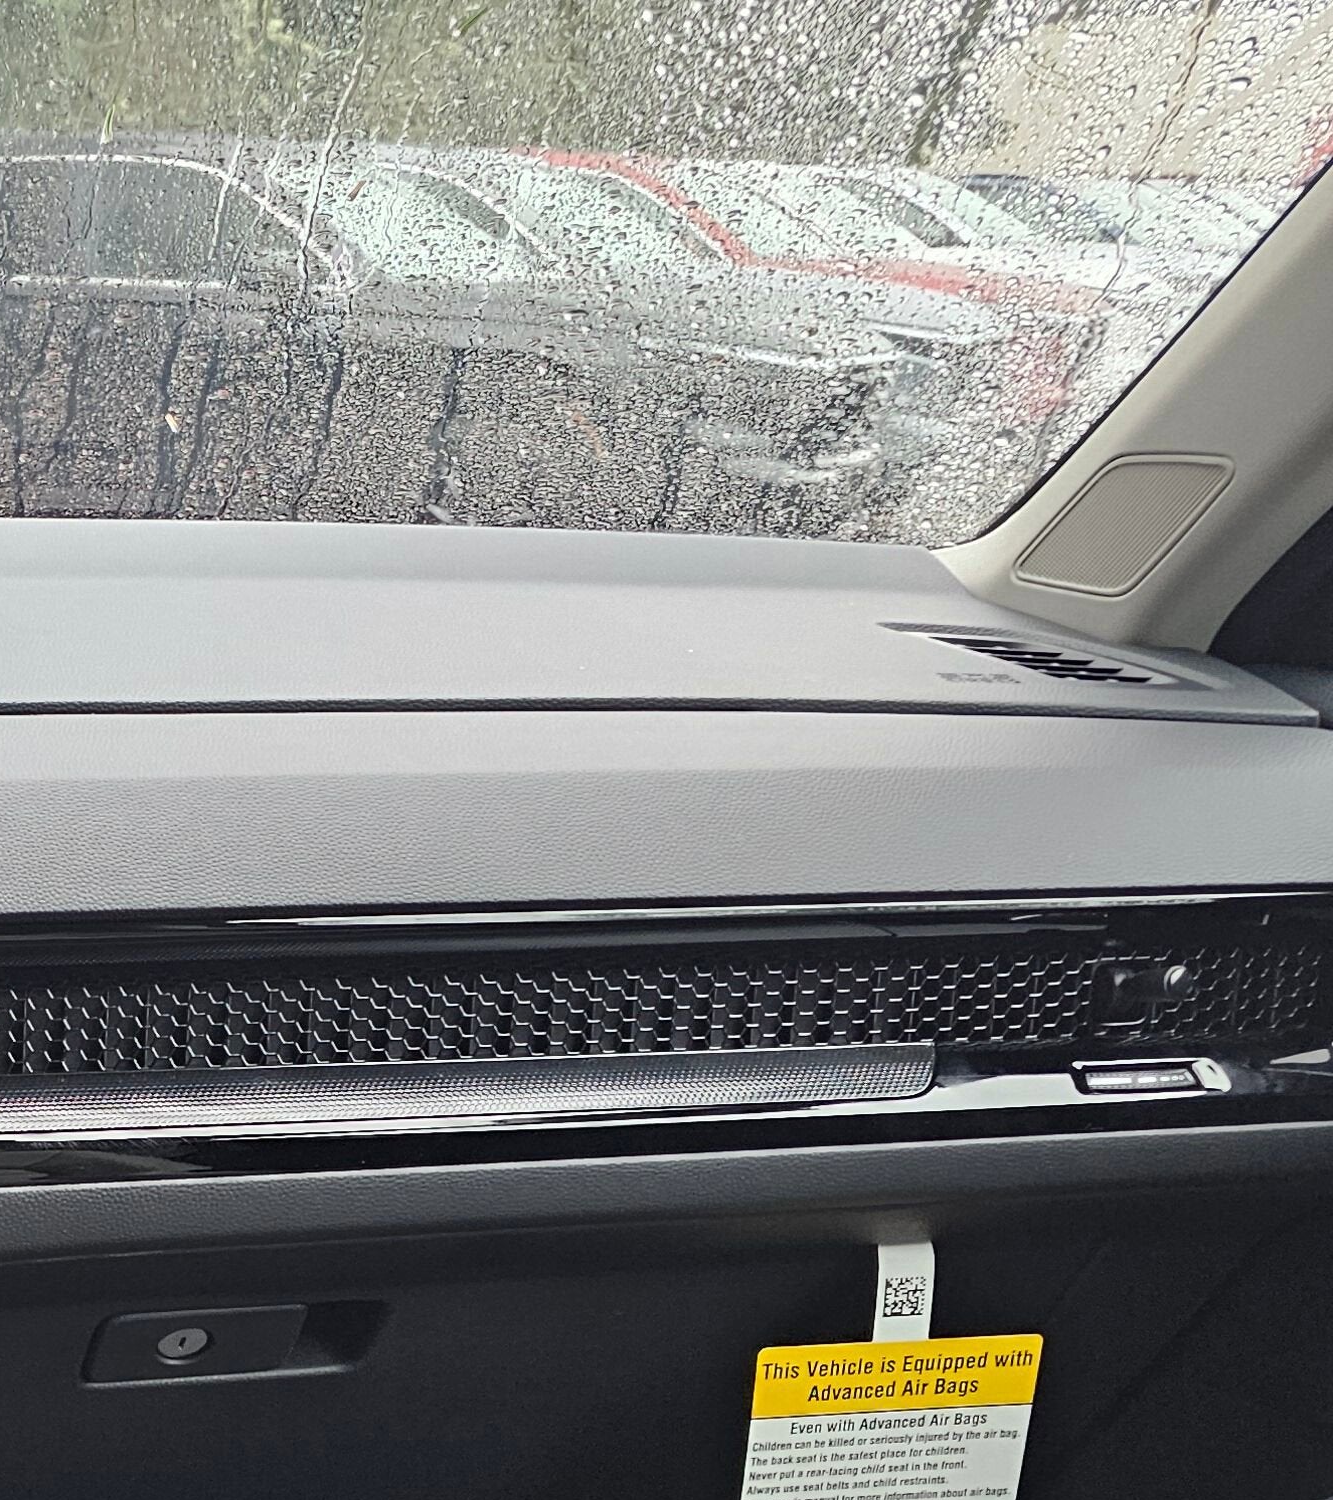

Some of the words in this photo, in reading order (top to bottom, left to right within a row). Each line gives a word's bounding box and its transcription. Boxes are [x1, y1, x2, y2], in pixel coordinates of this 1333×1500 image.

[762, 1362, 800, 1380] This
[807, 1358, 874, 1377] Vehicle
[880, 1357, 896, 1373] is
[902, 1351, 988, 1375] Equipped
[995, 1350, 1033, 1368] with
[807, 1381, 896, 1402] Advanced
[901, 1379, 929, 1396] Air
[934, 1378, 979, 1397] Bags
[790, 1421, 822, 1435] Even
[827, 1418, 855, 1432] with
[859, 1414, 926, 1431] Advanced
[930, 1413, 950, 1427] Air
[953, 1412, 988, 1428] Bags
[753, 1442, 792, 1452] Children
[795, 1441, 811, 1449] can
[814, 1440, 826, 1449] be
[828, 1437, 855, 1448] killed
[857, 1438, 867, 1446] or
[870, 1434, 913, 1446] seriously
[915, 1431, 950, 1443] injured
[953, 1430, 964, 1442] by
[966, 1430, 981, 1440] the
[984, 1429, 998, 1439] air
[1000, 1429, 1021, 1440] bag.
[751, 1457, 768, 1467] The
[771, 1455, 793, 1465] back
[795, 1455, 817, 1464] seat
[819, 1453, 828, 1463] is
[830, 1452, 846, 1462] the
[848, 1450, 878, 1461] safest
[880, 1448, 906, 1460] place
[909, 1448, 923, 1458] for
[749, 1471, 777, 1481] Never
[779, 1469, 795, 1480] put
[797, 1470, 804, 1478] a
[806, 1466, 858, 1478] rear-facing
[861, 1464, 886, 1475] child
[888, 1463, 909, 1473] seat
[911, 1462, 920, 1471] in
[923, 1461, 938, 1470] the
[746, 1485, 781, 1496] Always
[783, 1484, 800, 1493] use
[803, 1482, 824, 1492] seat
[826, 1480, 850, 1491] belts
[852, 1479, 870, 1489] and
[873, 1477, 897, 1488] child
[883, 1490, 938, 1500] information
[940, 1488, 967, 1498] about
[969, 1487, 984, 1497] air
